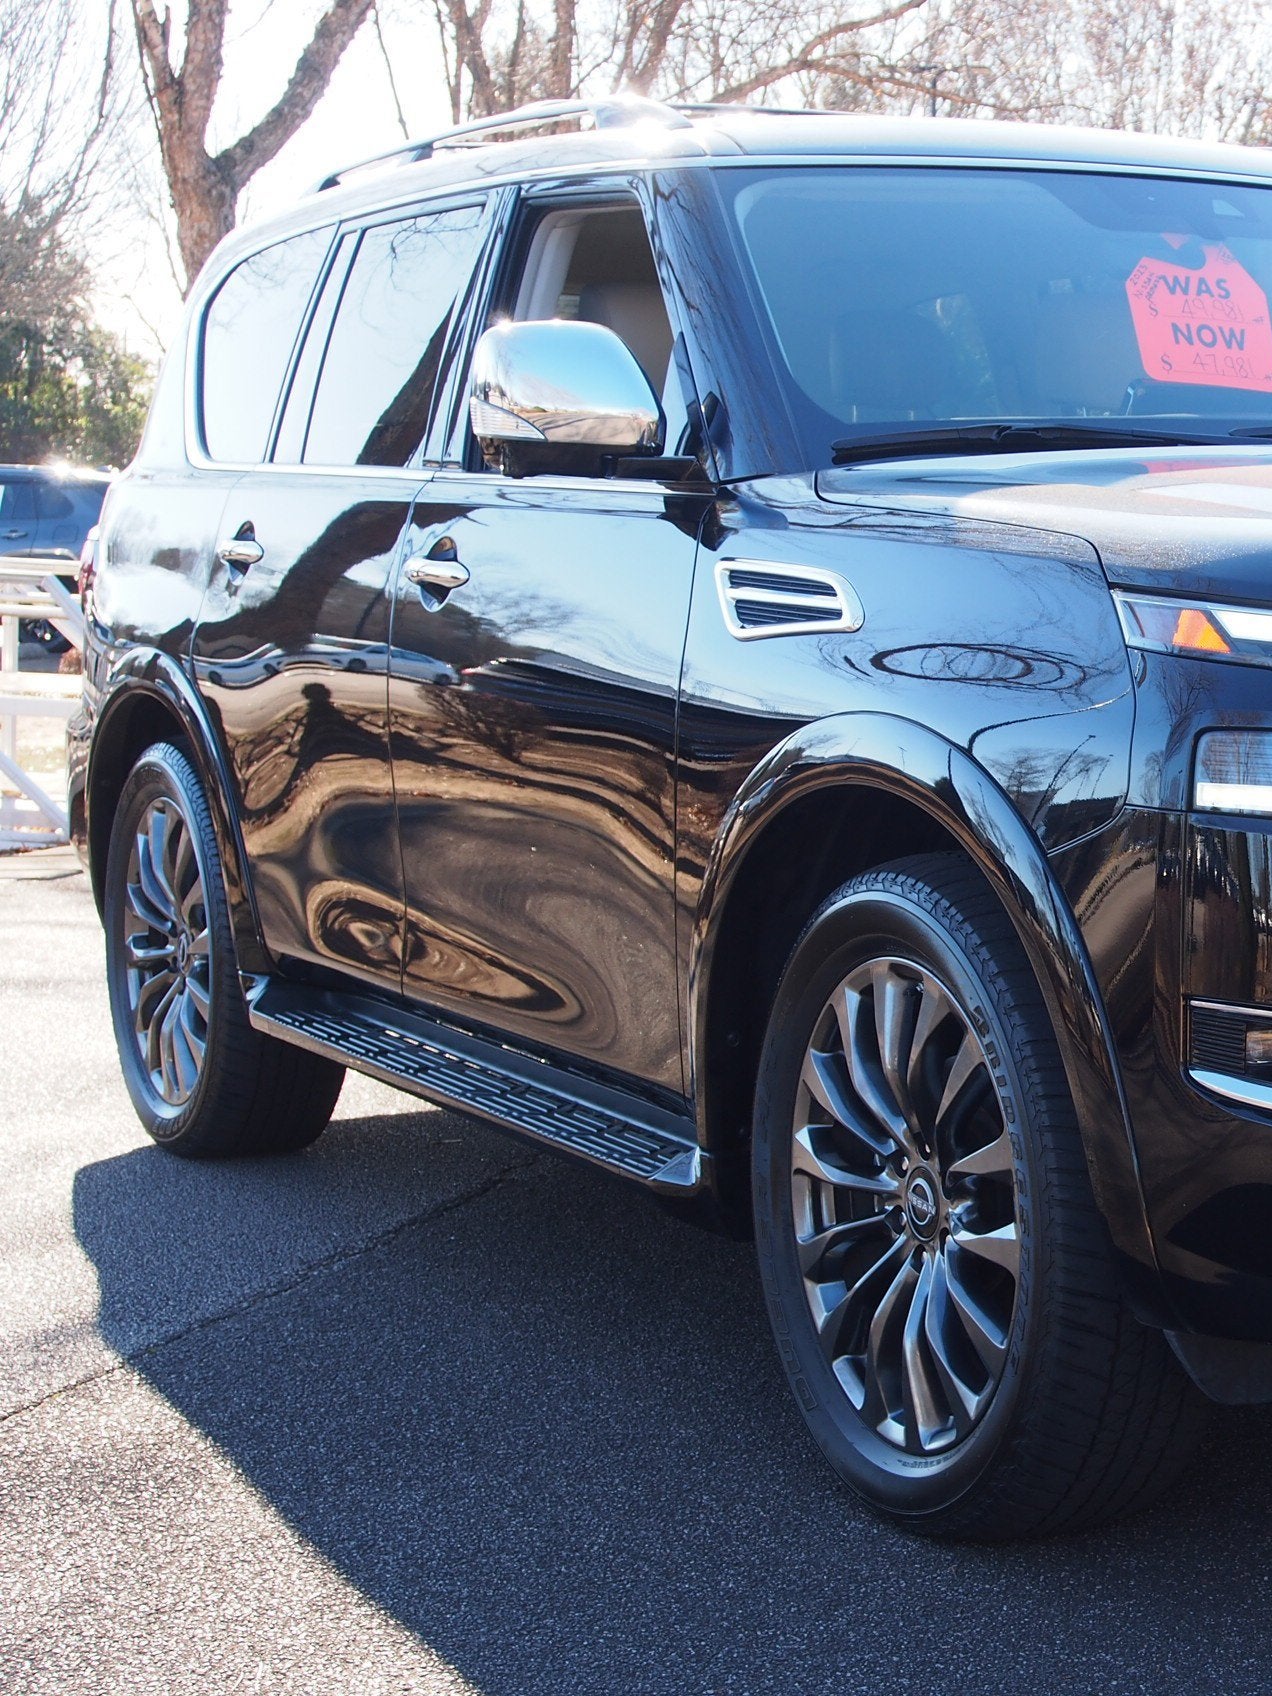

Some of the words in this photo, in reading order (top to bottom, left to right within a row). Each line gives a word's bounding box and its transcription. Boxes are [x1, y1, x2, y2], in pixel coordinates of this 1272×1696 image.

[1158, 274, 1231, 300] WAS
[1148, 303, 1159, 318] $
[1171, 322, 1246, 351] NOW
[1160, 352, 1173, 375] $
